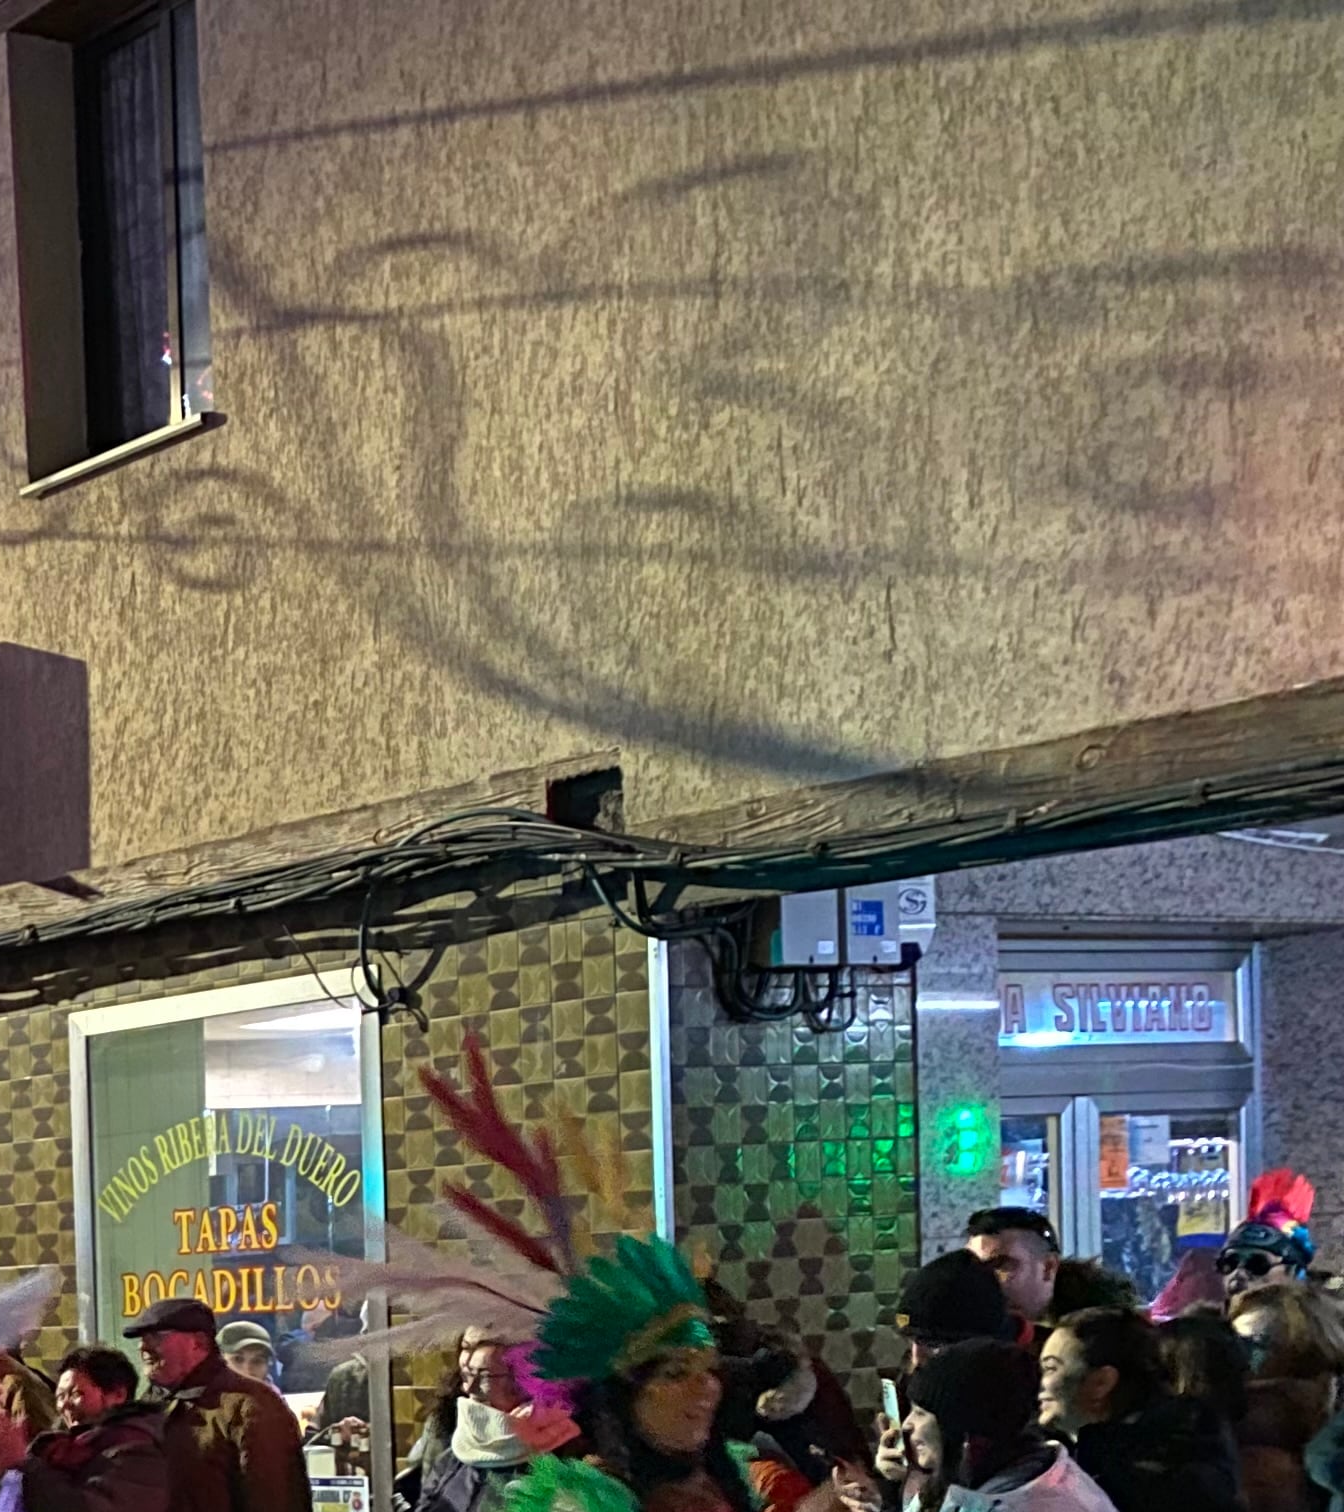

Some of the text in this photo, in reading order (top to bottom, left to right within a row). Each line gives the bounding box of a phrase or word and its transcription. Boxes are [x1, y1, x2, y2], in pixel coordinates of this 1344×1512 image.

[1051, 981, 1213, 1033] SILVIANO
[98, 1145, 160, 1224] VINOS
[235, 1111, 279, 1162] DEL
[279, 1123, 361, 1208] DUERO
[172, 1201, 280, 1256] TAPAS
[120, 1264, 342, 1318] BOCADILLOS
